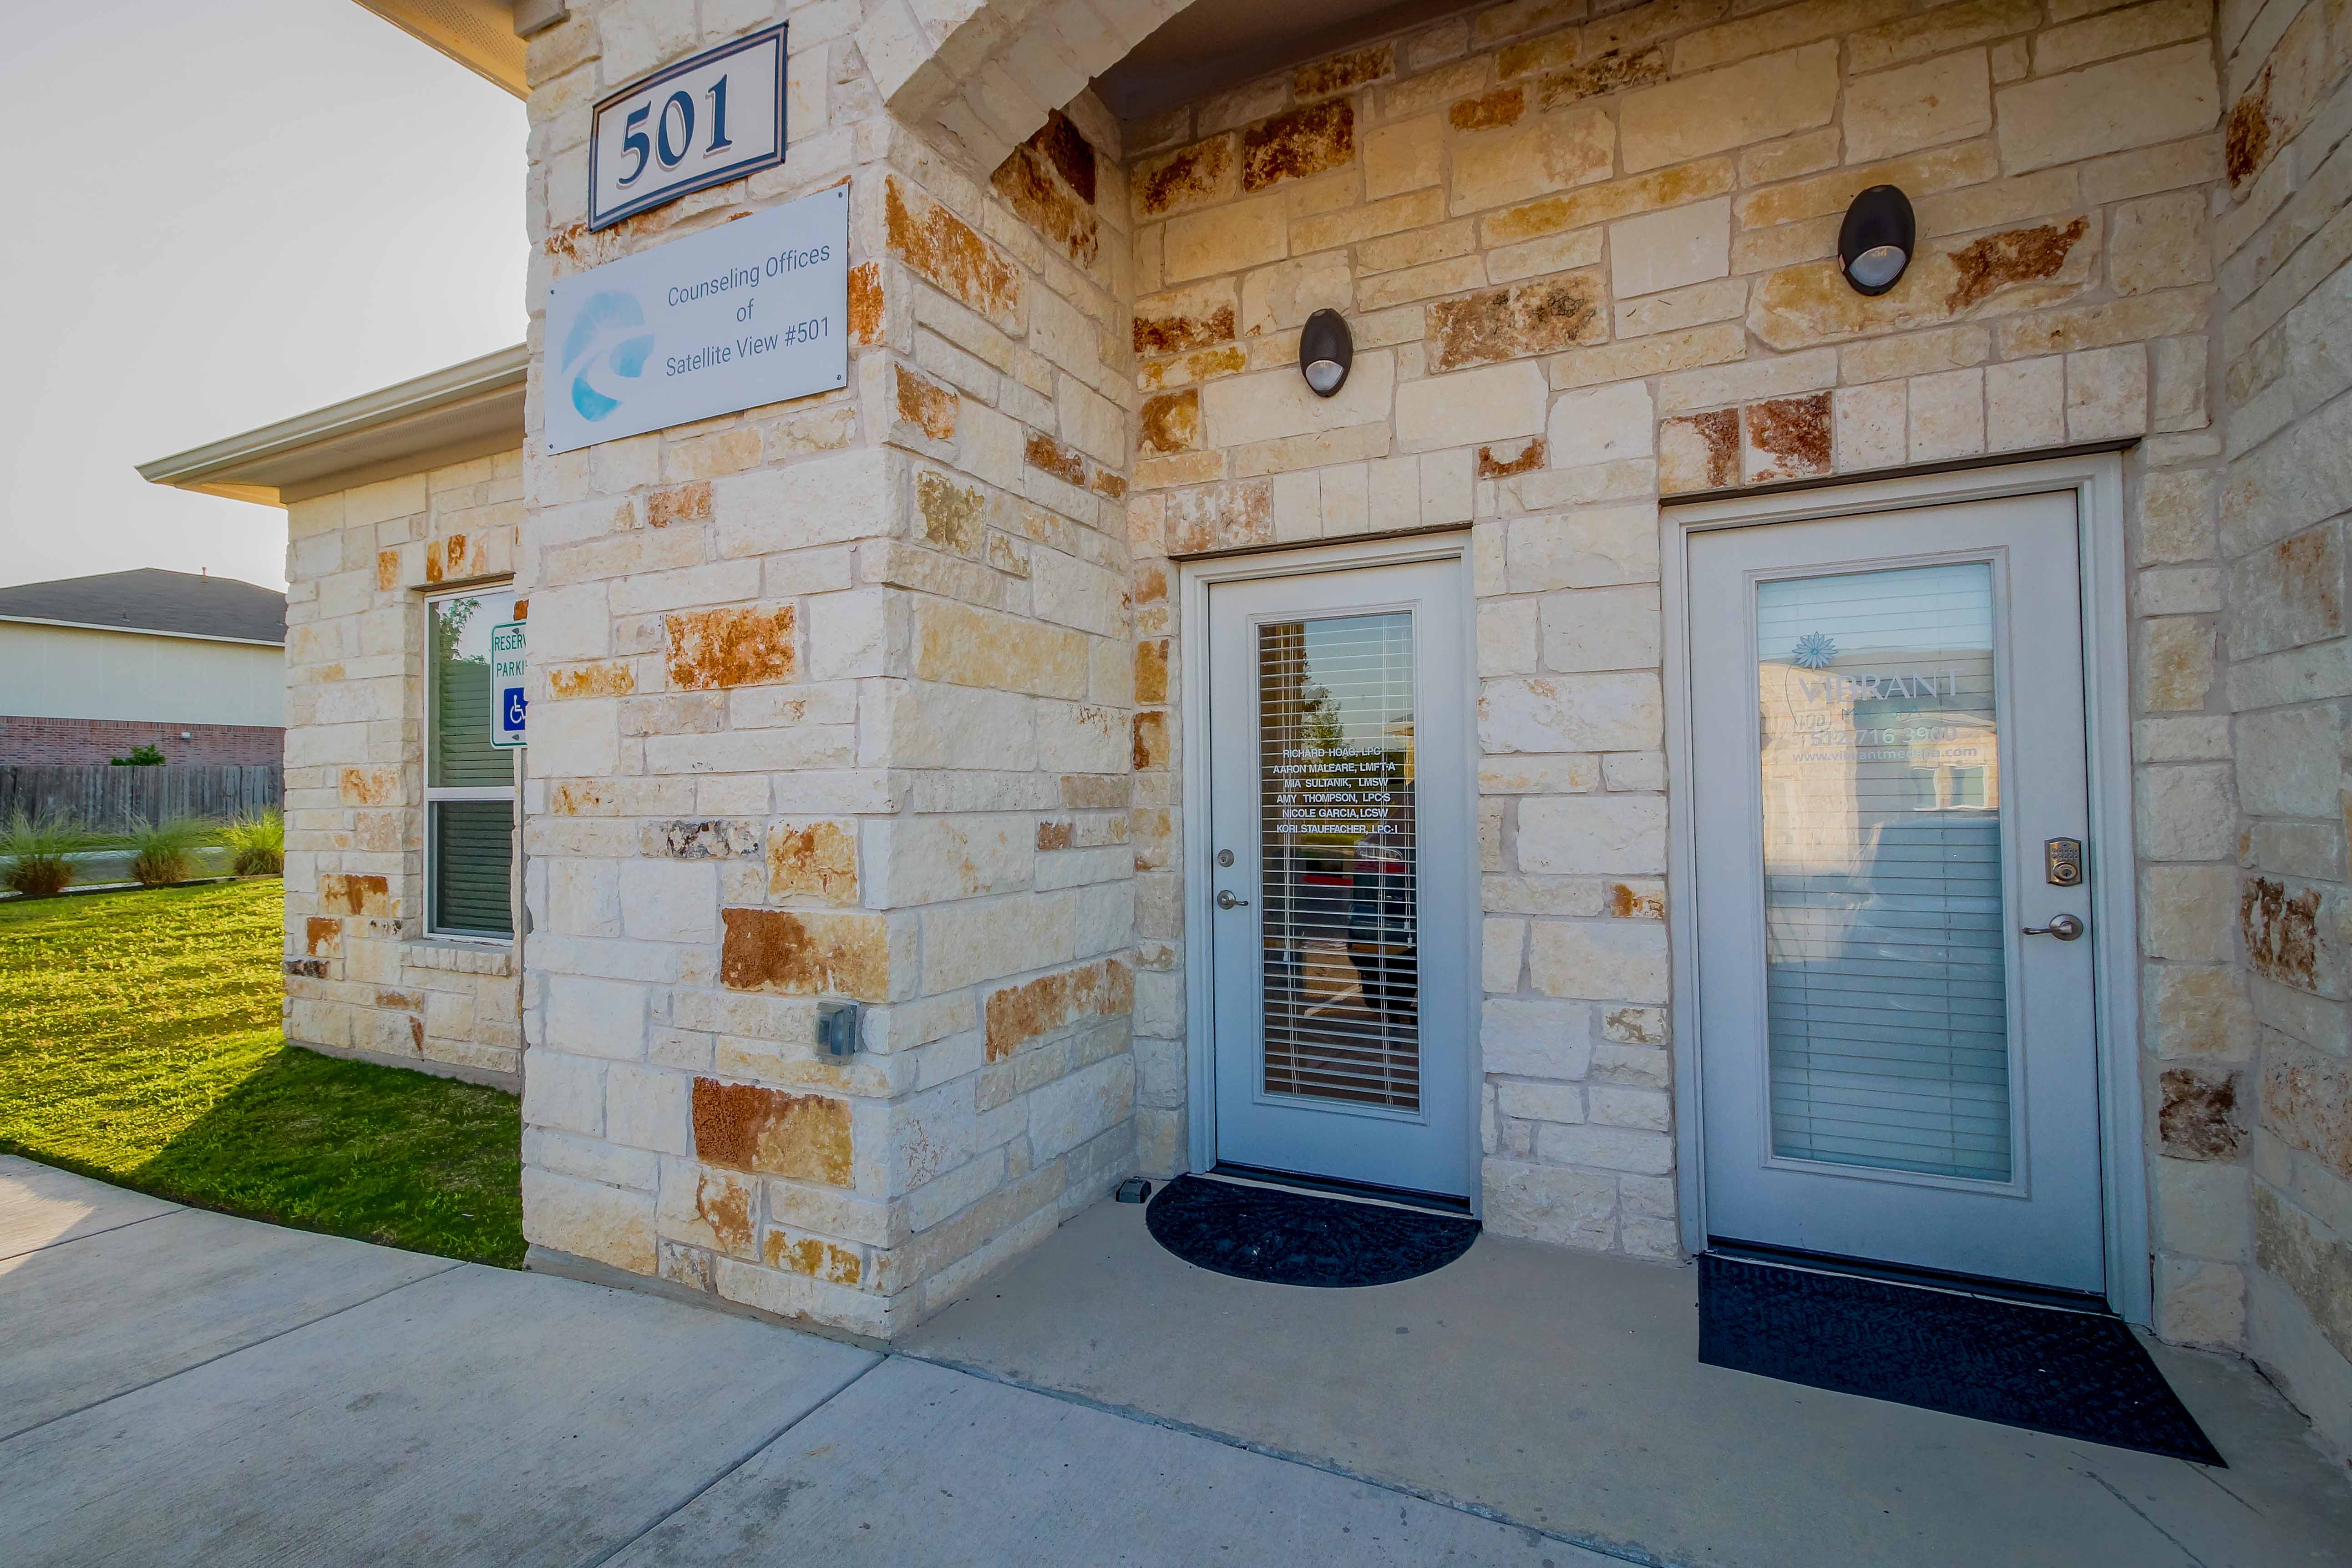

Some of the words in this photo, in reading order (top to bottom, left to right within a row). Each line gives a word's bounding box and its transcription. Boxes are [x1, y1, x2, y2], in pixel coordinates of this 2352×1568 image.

[617, 73, 732, 187] 501
[668, 266, 760, 307] Counseling
[766, 244, 831, 278] Offices
[736, 299, 754, 323] of
[666, 344, 731, 377] Satellite
[736, 336, 778, 359] View
[784, 316, 830, 346] #501
[1798, 668, 1965, 704] VIBRANT
[1857, 728, 1895, 744] 716
[1903, 726, 1957, 743] 3900
[1283, 749, 1325, 758] RICHARD
[1329, 748, 1358, 757] HOAG,
[1273, 764, 1306, 774] AARON
[1309, 762, 1357, 773] MALEARE,
[1285, 779, 1301, 788] MIA
[1305, 778, 1351, 788] SULTANIK,
[1358, 778, 1388, 787] LMSW
[1276, 794, 1297, 803] AMY
[1303, 794, 1358, 804] THOMPSON,
[1282, 809, 1316, 818] NICOLE
[1319, 809, 1359, 819] GARCIA,
[1360, 808, 1388, 817] LCSW
[1277, 824, 1298, 833] KORI
[1301, 824, 1368, 835] STAUFFACHER,
